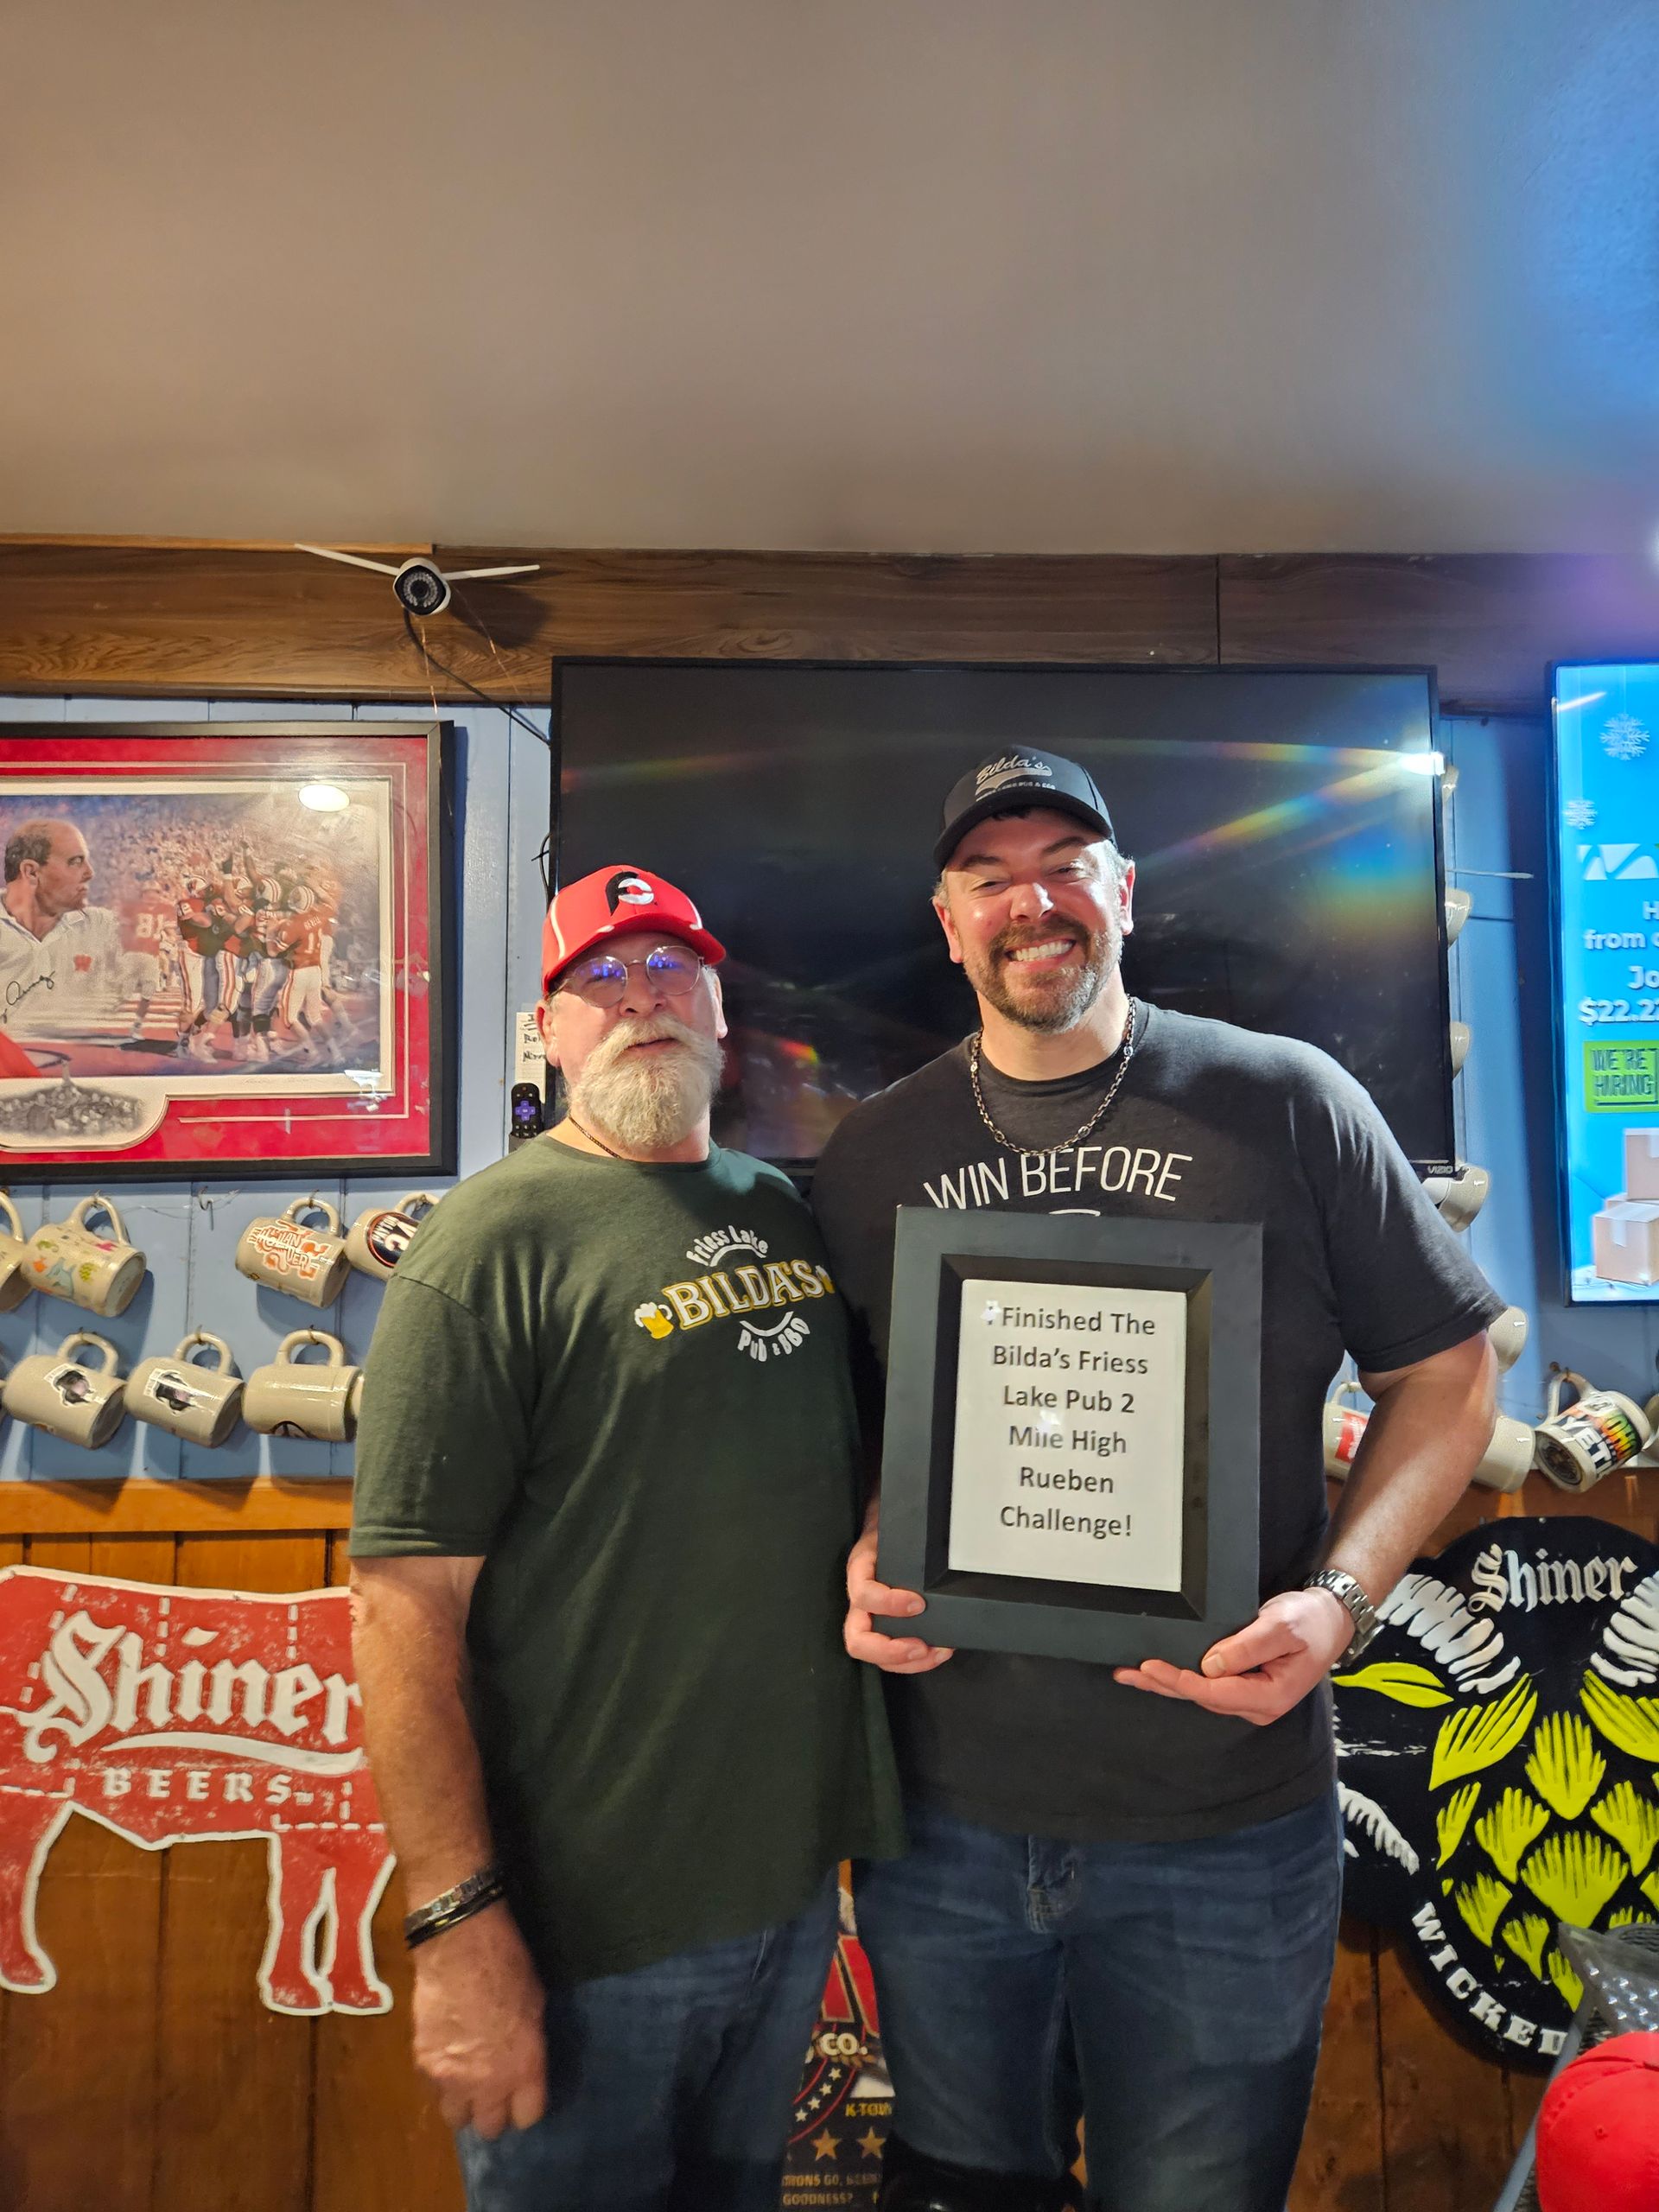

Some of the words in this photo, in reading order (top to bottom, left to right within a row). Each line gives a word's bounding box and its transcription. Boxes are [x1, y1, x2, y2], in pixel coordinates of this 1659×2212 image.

[976, 755, 1044, 785] Bilda's
[1584, 928, 1647, 950] from
[1591, 1048, 1649, 1071] WE'RE
[1594, 1073, 1654, 1096] HIRING
[923, 1157, 1009, 1210] WIN
[1020, 1146, 1193, 1202] BEFORE
[1427, 1165, 1453, 1175] VIZIO
[686, 1230, 730, 1267] Friess
[728, 1225, 768, 1254] Lake
[661, 1259, 824, 1331] BILDA'S
[1001, 1306, 1103, 1332] Finished
[1110, 1313, 1155, 1335] The
[994, 1344, 1071, 1370] Bilda's
[1079, 1351, 1148, 1375] Friess
[1004, 1385, 1058, 1408] Lake
[1066, 1389, 1112, 1412] Pub
[1121, 1393, 1135, 1414] 2
[1008, 1426, 1064, 1449] Mile
[1071, 1430, 1127, 1458] High
[1020, 1466, 1114, 1494] Rueben
[1001, 1506, 1131, 1540] Challenge!
[1469, 1543, 1638, 1612] Shiner
[15, 1610, 363, 1763] Shiner
[103, 1767, 293, 1804] BEERS
[822, 2032, 868, 2056] CO.
